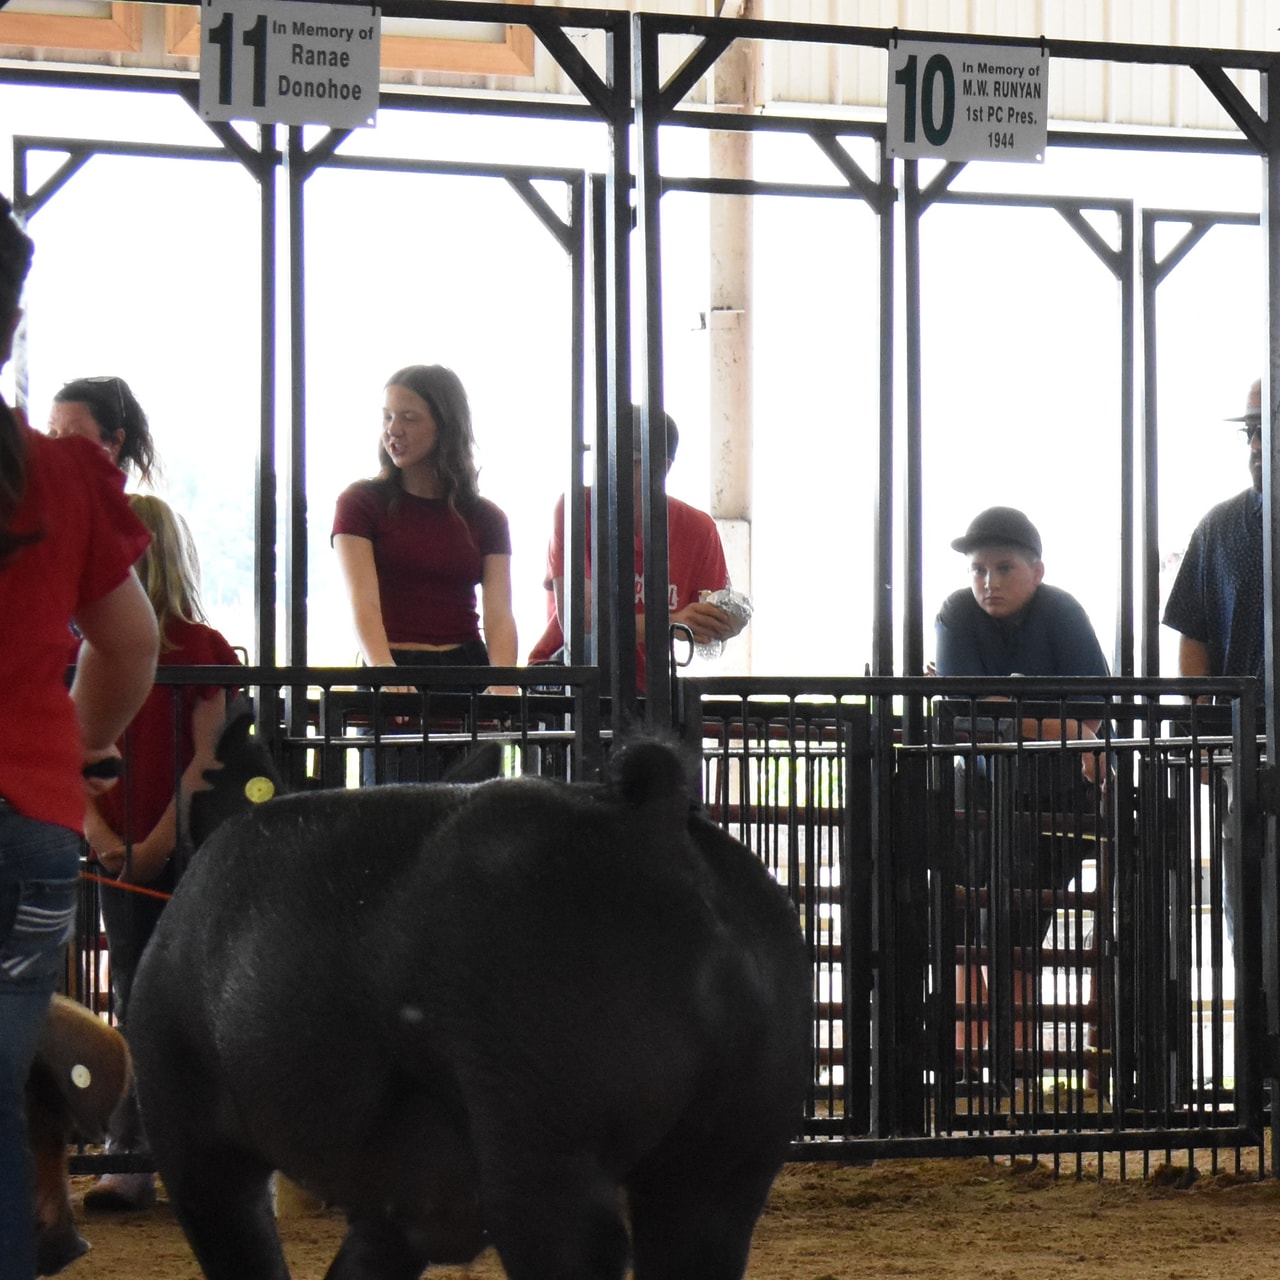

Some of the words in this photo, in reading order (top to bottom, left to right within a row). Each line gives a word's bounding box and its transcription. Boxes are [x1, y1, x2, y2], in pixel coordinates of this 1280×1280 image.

[272, 20, 287, 34] In
[292, 22, 353, 42] Memory
[358, 26, 374, 40] of
[208, 12, 268, 107] 11
[292, 43, 350, 67] Ranae
[962, 62, 973, 73] In
[977, 63, 1025, 78] Memory
[1028, 65, 1040, 76] of
[278, 75, 362, 100] Donohoe
[962, 79, 989, 97] M.W.
[994, 81, 1042, 99] RUNYAN
[895, 53, 956, 147] 10
[966, 106, 983, 122] 1st
[988, 106, 1003, 123] PC
[1008, 107, 1037, 125] Pres.
[988, 132, 1015, 149] 1944
